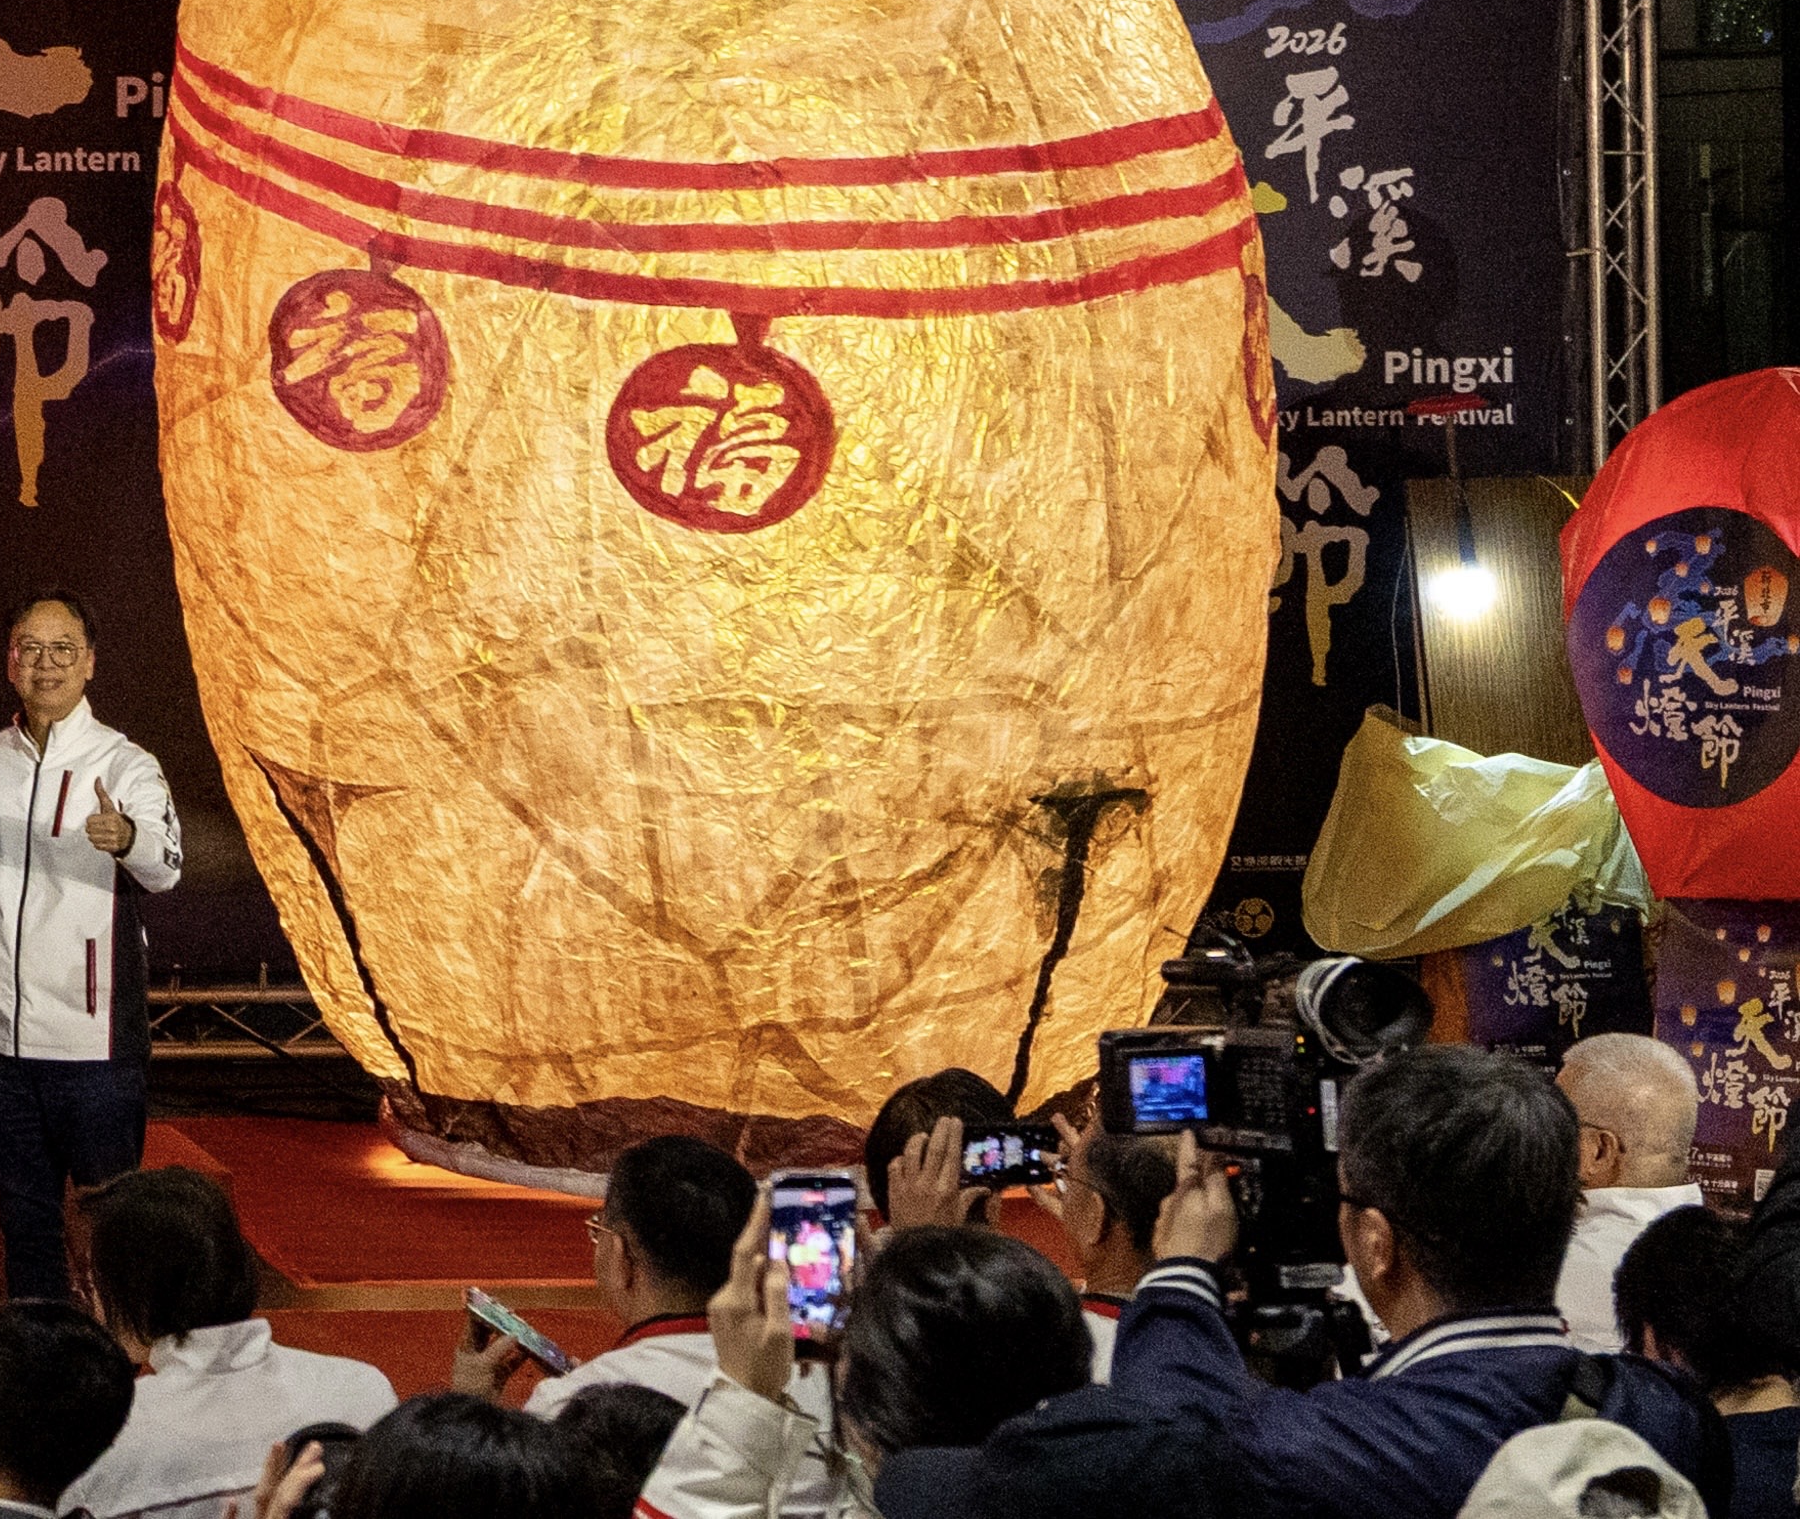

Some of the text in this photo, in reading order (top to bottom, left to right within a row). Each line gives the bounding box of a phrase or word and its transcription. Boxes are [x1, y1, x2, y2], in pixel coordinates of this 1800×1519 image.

[1264, 23, 1347, 59] 2026
[16, 144, 142, 173] Lantern
[1264, 66, 1424, 282] 平溪
[1383, 347, 1514, 393] Pingxi
[1307, 405, 1404, 426] Lantern
[630, 364, 802, 517] 福
[1629, 617, 1744, 789] 天燈節
[1743, 686, 1782, 701] Pingxi
[1700, 998, 1792, 1154] 天燈節
